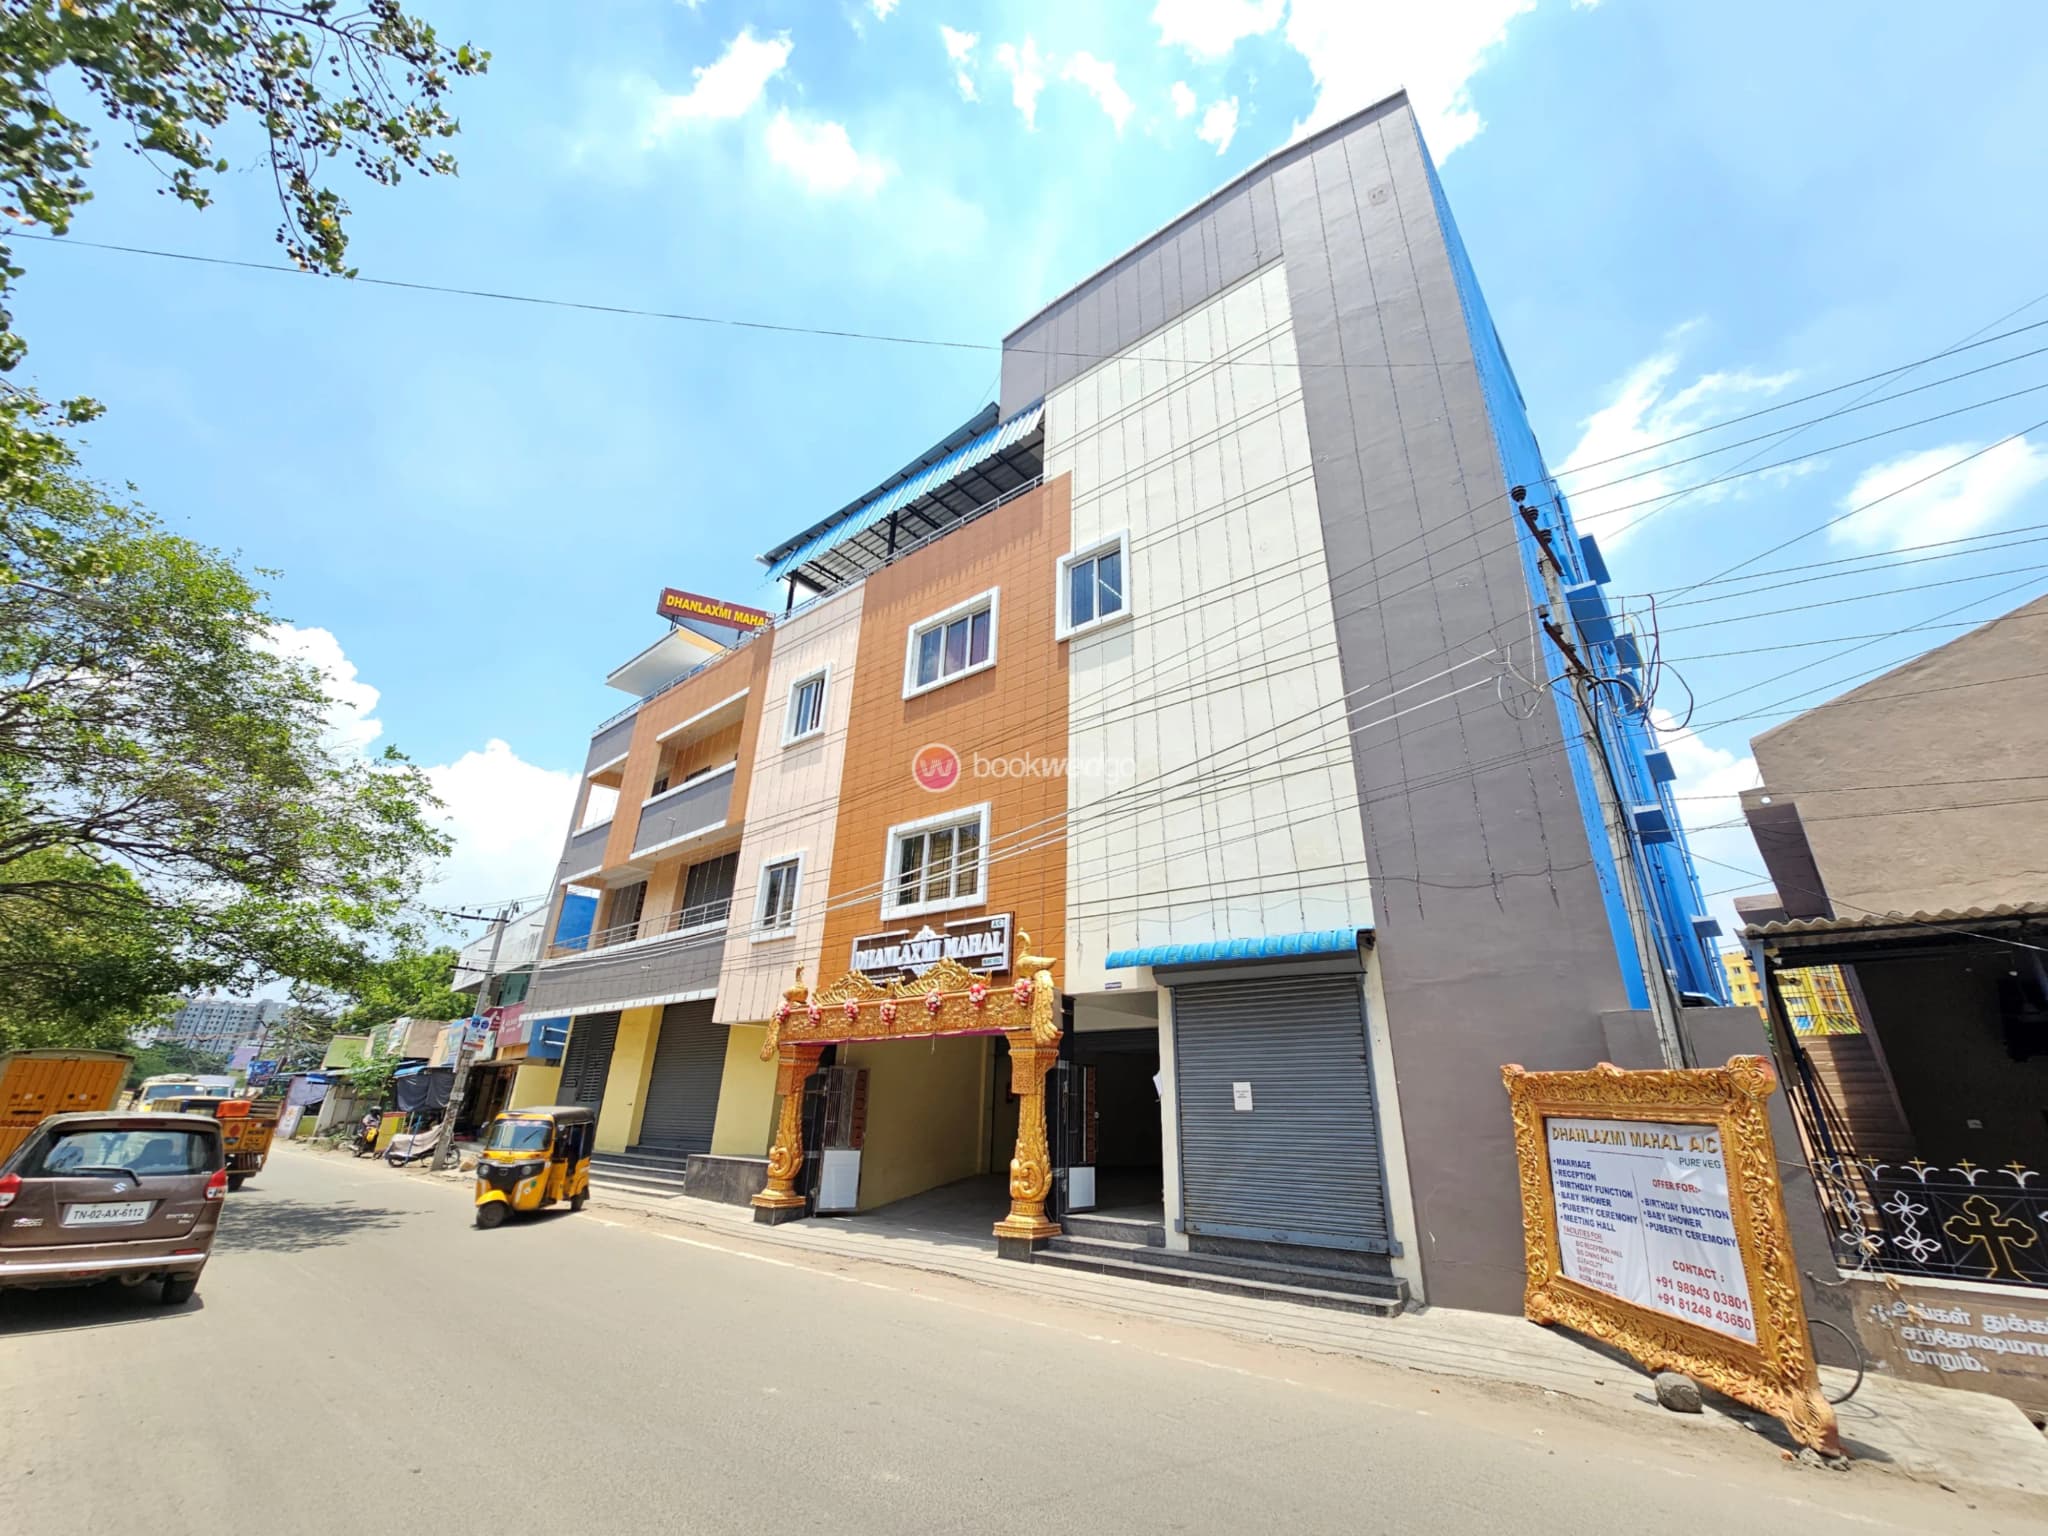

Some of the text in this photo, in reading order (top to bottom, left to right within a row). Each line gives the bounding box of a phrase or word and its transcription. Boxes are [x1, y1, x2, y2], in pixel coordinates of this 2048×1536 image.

[666, 594, 731, 620] DHANLAXMI
[854, 931, 1004, 970] DHANLAXMI MAHAL
[1552, 1127, 1718, 1154] DHANLAXMI MAHAL A/C
[1556, 1158, 1591, 1169] MARRIAGE
[1679, 1157, 1721, 1169] PURE VEG
[1558, 1169, 1597, 1181] RECEPTION
[1652, 1179, 1675, 1190] OFFER
[1560, 1180, 1633, 1198] BIRTHDAY FUNCTION
[1561, 1192, 1612, 1207] BABY SHOWER
[1645, 1198, 1730, 1220] BIRTHDAY FUNCTION
[73, 1206, 145, 1220] TN-02-AX-6112
[1562, 1202, 1638, 1224] PUBERTY CEREMONY
[1647, 1210, 1702, 1228] BABY SHOWER
[1563, 1214, 1616, 1232] MEETING HALL
[1649, 1222, 1736, 1247] PUBERTY CEREMONY
[1672, 1260, 1717, 1280] CONTACT
[1656, 1277, 1748, 1311] +91 98943 03801
[1658, 1293, 1751, 1330] +91 81248 43650
